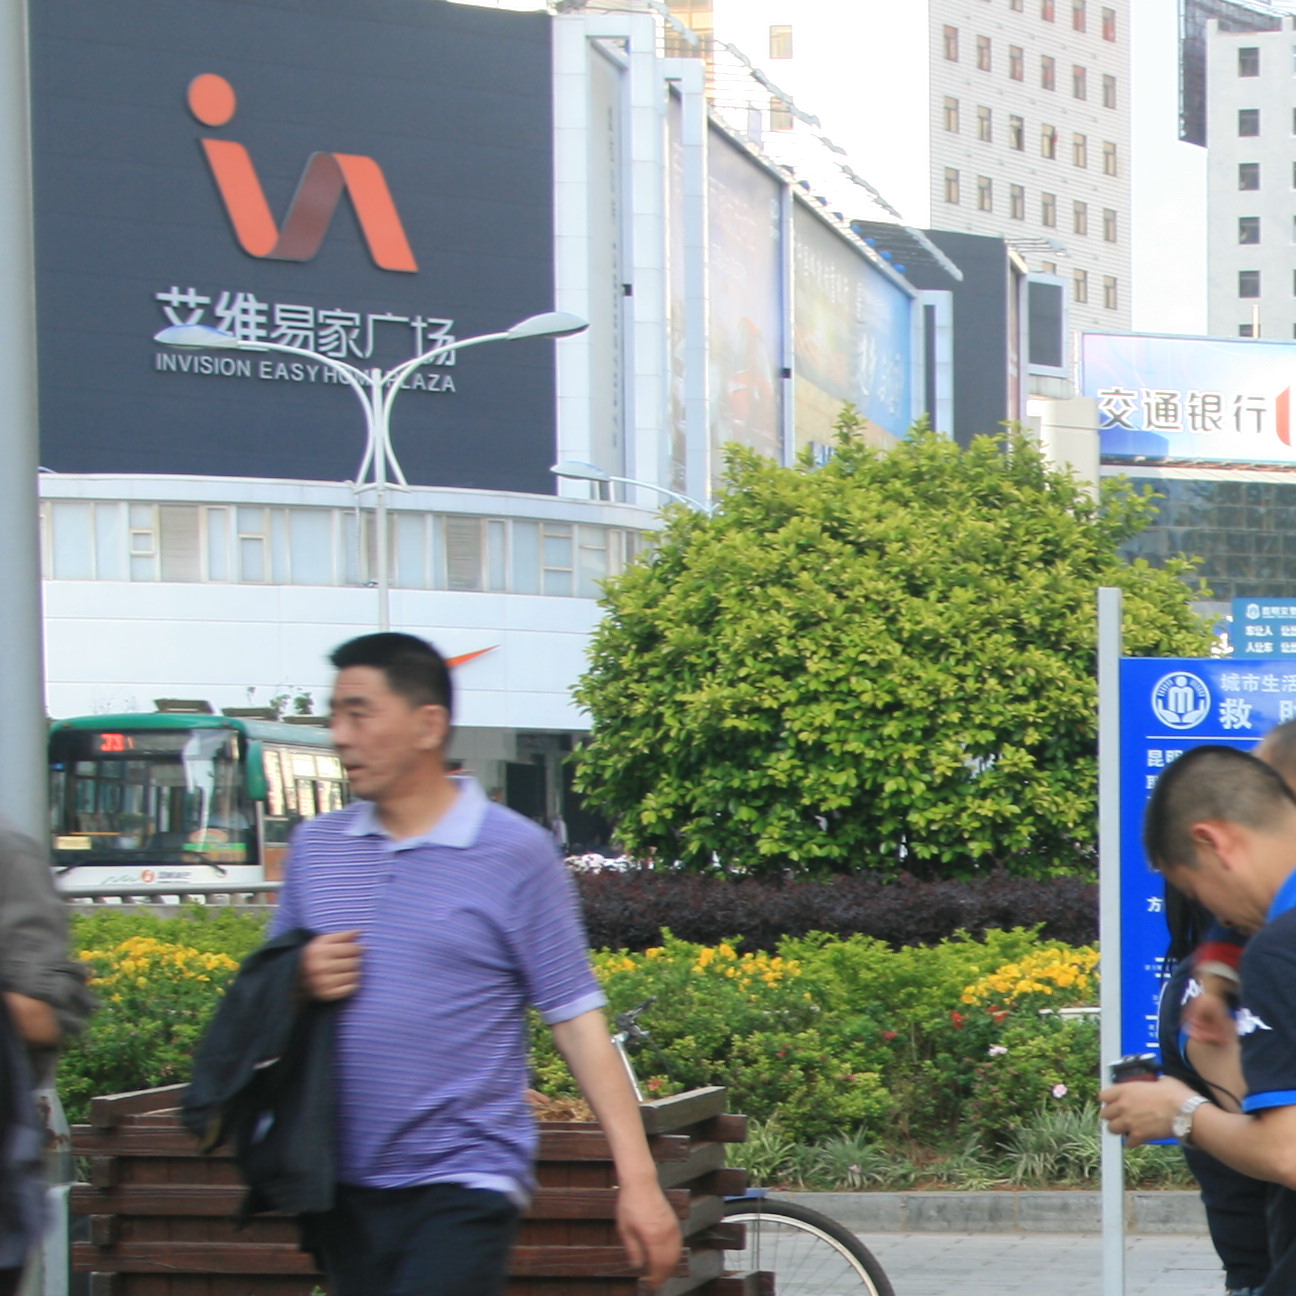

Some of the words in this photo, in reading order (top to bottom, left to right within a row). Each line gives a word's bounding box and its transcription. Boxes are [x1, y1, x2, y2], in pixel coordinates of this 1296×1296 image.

[156, 286, 456, 366] 艾维易家广场
[156, 353, 250, 378] INVISION
[259, 361, 323, 383] EASY
[323, 366, 381, 388] HOM
